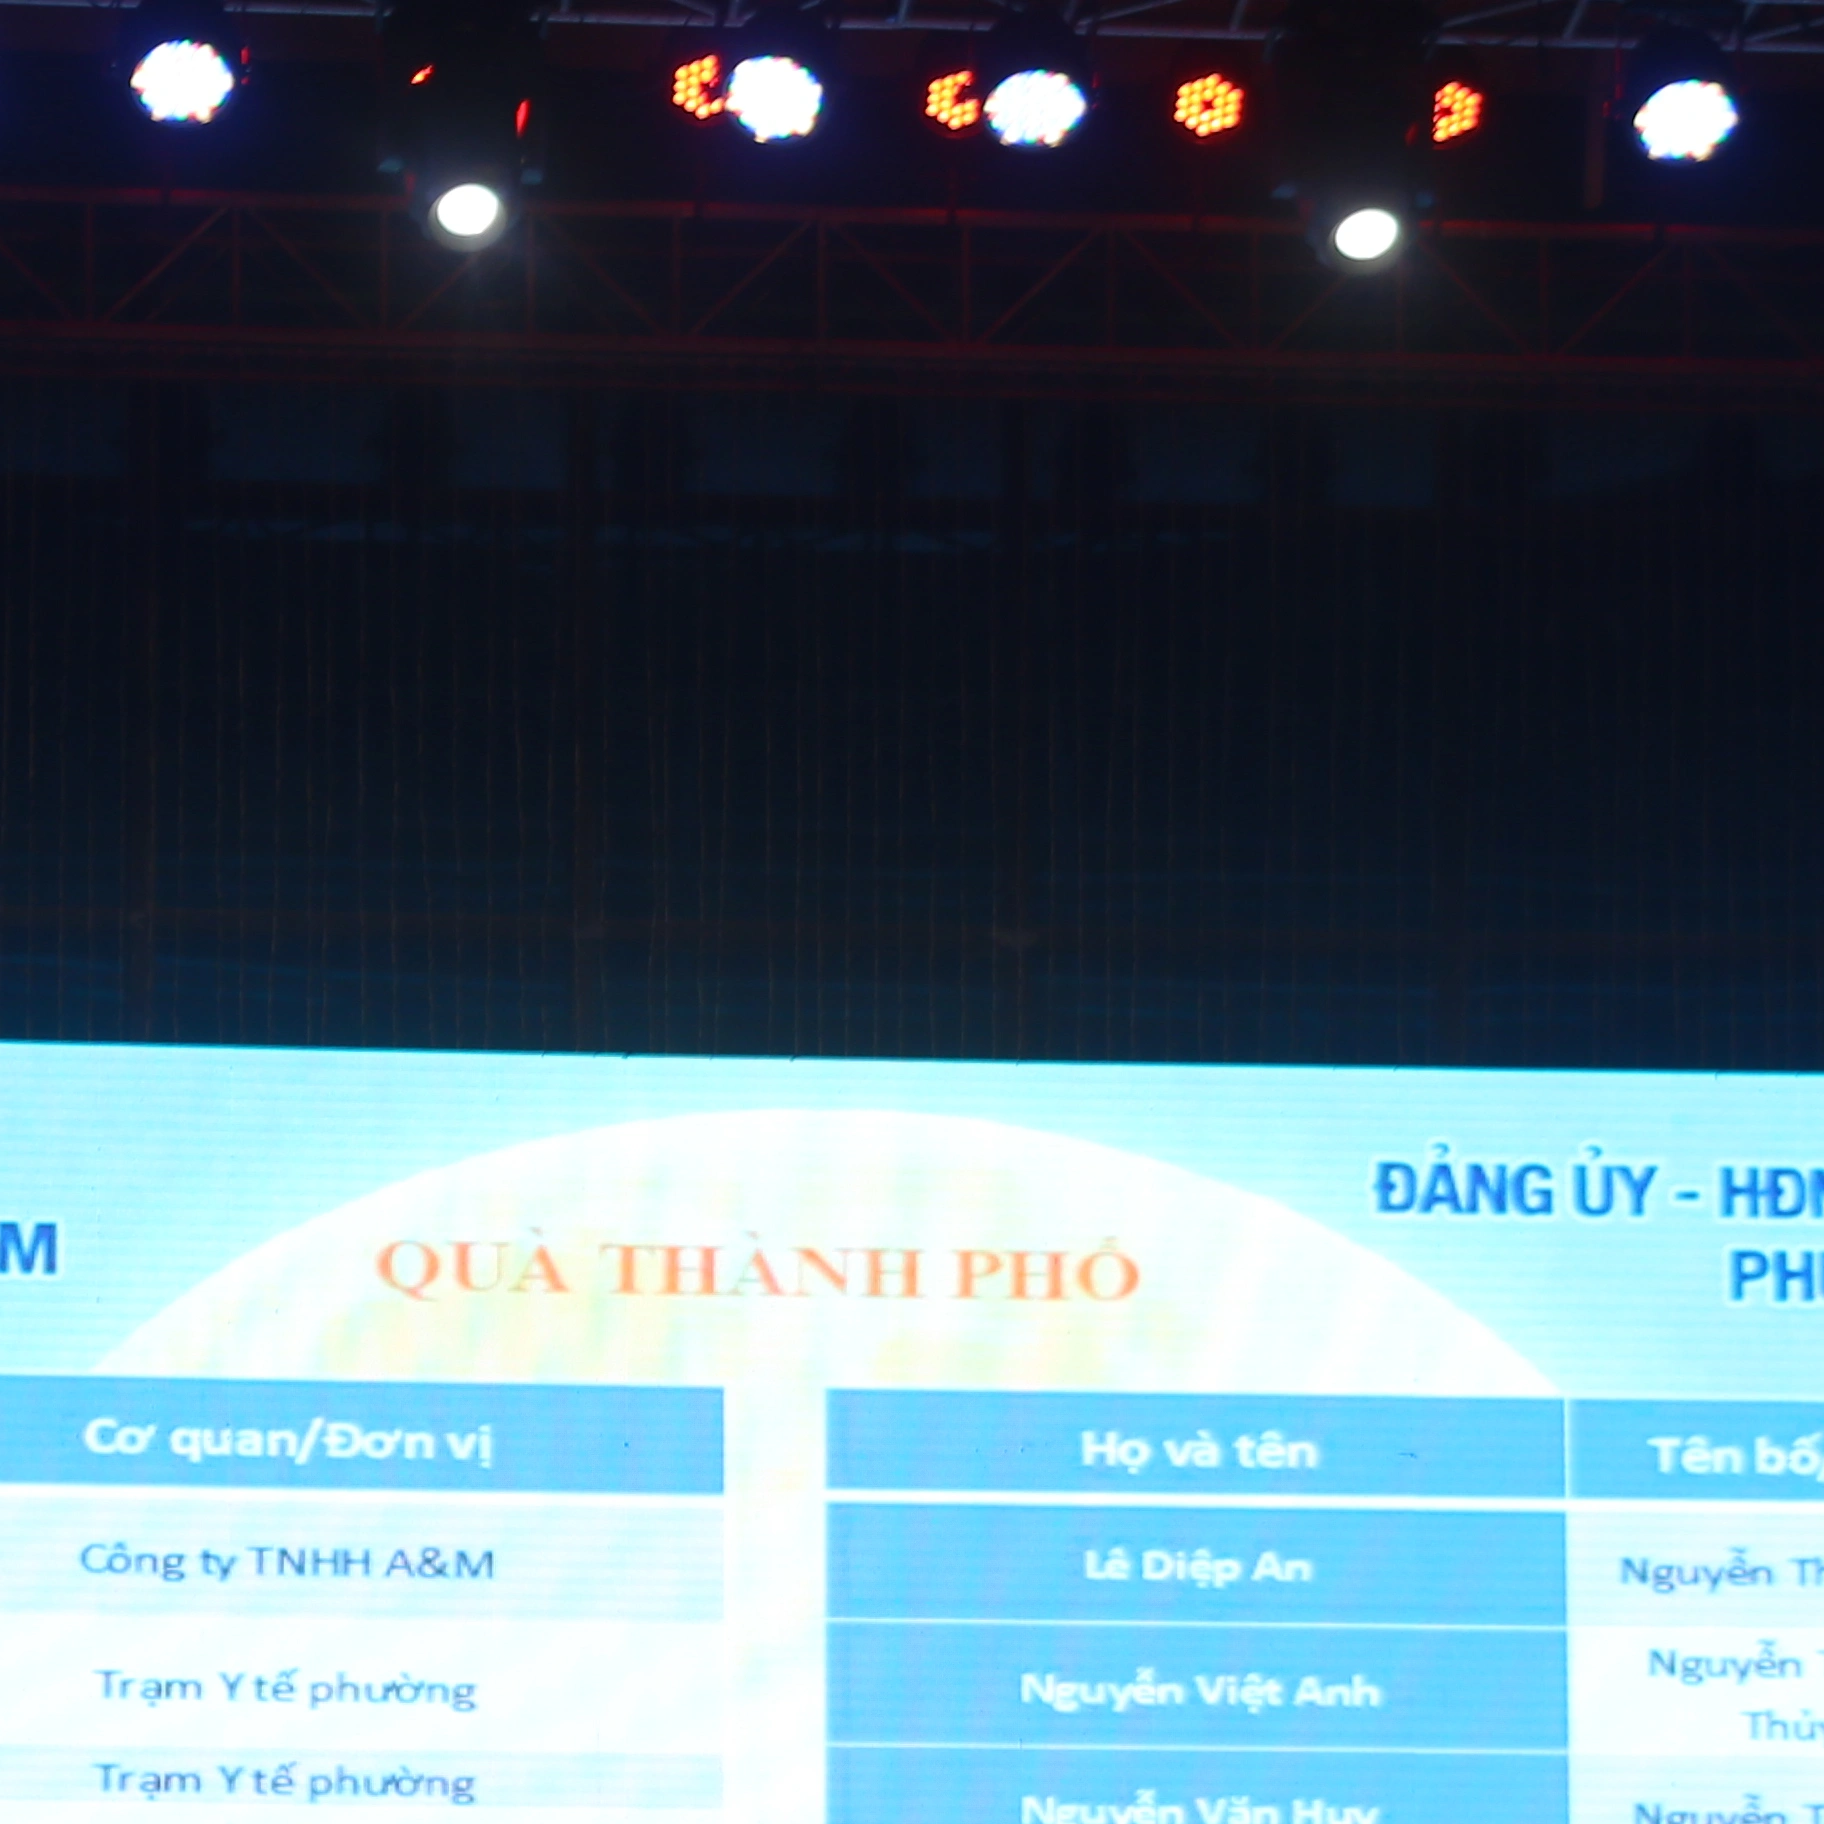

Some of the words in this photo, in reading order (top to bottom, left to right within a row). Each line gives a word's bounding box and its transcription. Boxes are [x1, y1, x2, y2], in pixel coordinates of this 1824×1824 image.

[1374, 1143, 1554, 1217] ĐẢNG
[1573, 1145, 1659, 1218] ỦY
[1676, 1190, 1701, 1202] -
[374, 1226, 571, 1302] QUÀ
[599, 1230, 922, 1298] THÀNH
[951, 1236, 1142, 1301] PHỐ
[82, 1415, 158, 1456] Cơ
[168, 1415, 437, 1466] quan/Đơn
[444, 1423, 494, 1469] vị
[1080, 1429, 1154, 1476] Họ
[1162, 1428, 1223, 1468] và
[1233, 1429, 1321, 1470] tên
[1646, 1433, 1746, 1476] Tên
[77, 1539, 188, 1584] Công
[197, 1547, 240, 1584] ty
[246, 1544, 373, 1579] TNHH
[383, 1544, 496, 1581] A&M
[1084, 1545, 1133, 1581] Lê
[1141, 1547, 1245, 1589] Diệp
[1250, 1550, 1314, 1583] An
[1618, 1545, 1778, 1595] Nguyễn
